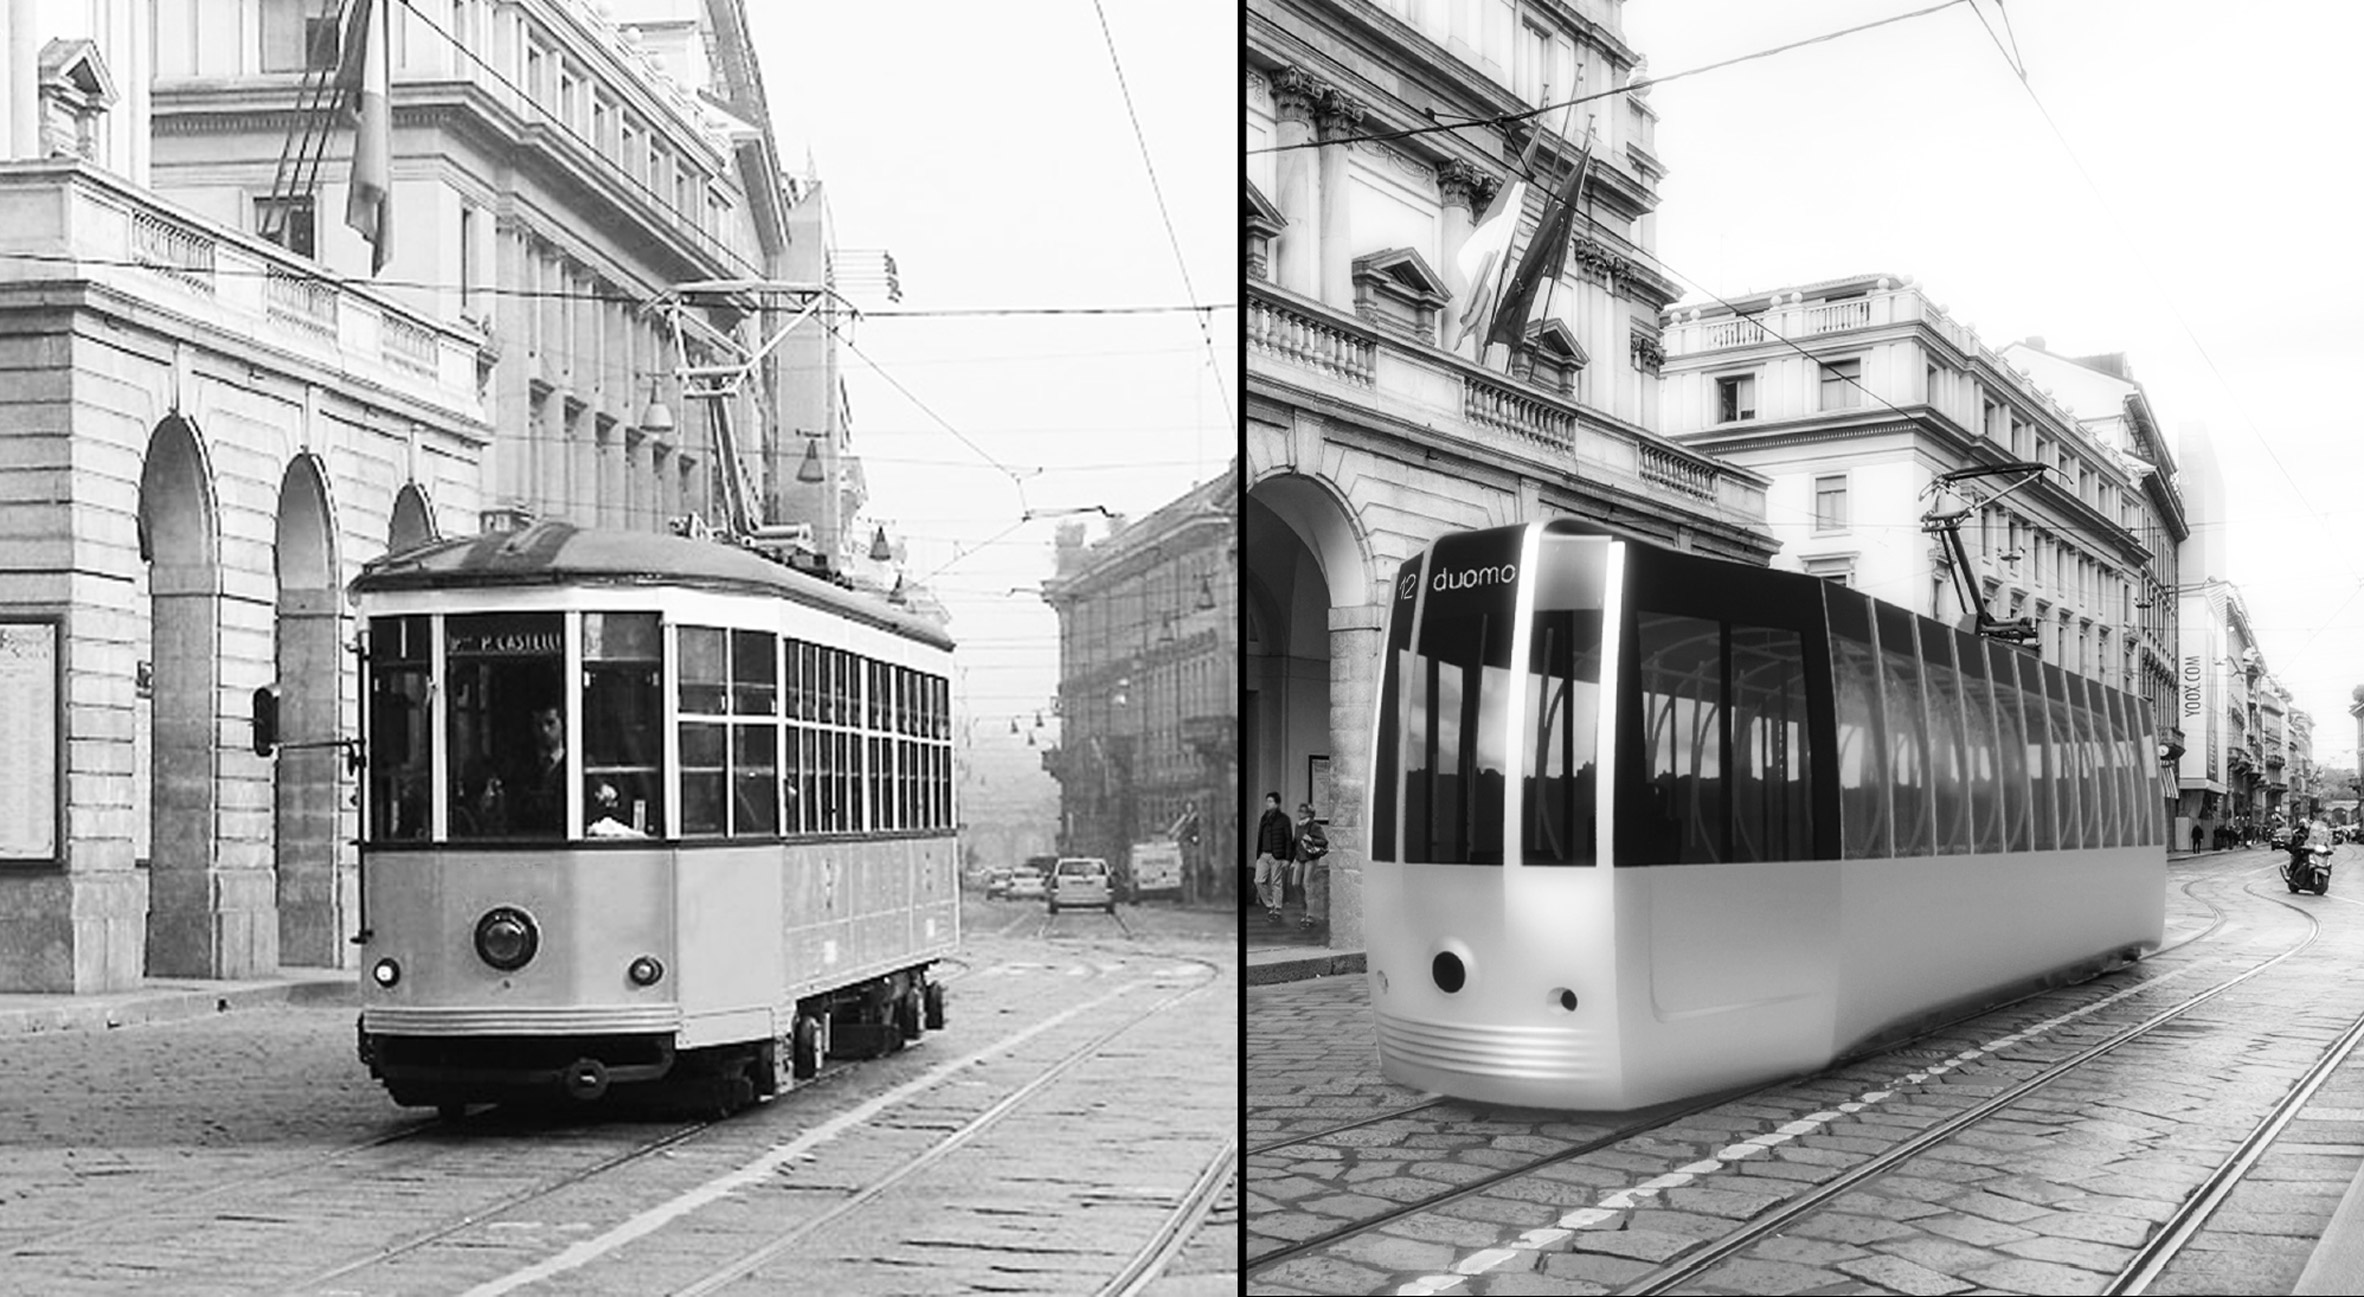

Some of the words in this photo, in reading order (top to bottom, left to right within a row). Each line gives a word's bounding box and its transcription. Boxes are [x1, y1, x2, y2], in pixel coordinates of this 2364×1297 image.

[1399, 573, 1416, 600] 12
[1433, 564, 1516, 591] duomo
[2184, 655, 2201, 718] YOOX.COM
